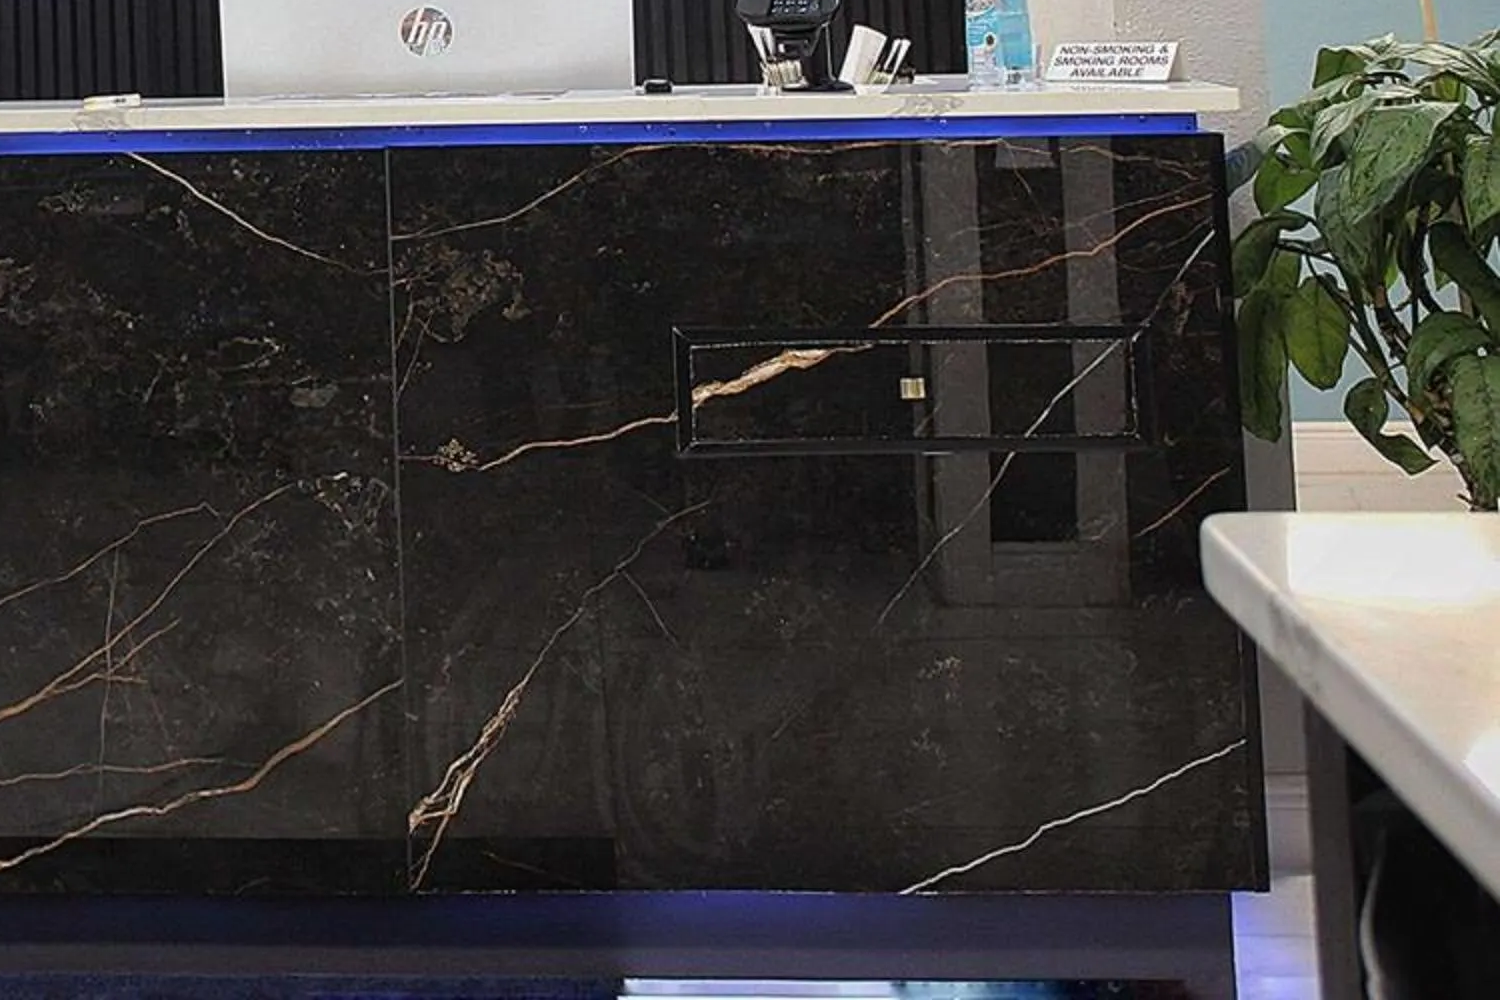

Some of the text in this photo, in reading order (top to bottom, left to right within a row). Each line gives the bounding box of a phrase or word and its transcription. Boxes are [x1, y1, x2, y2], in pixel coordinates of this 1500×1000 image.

[1060, 44, 1169, 55] NON-SMOKING &
[1054, 55, 1169, 66] SMOKING ROOMS
[1069, 67, 1145, 77] AVAILABLE
